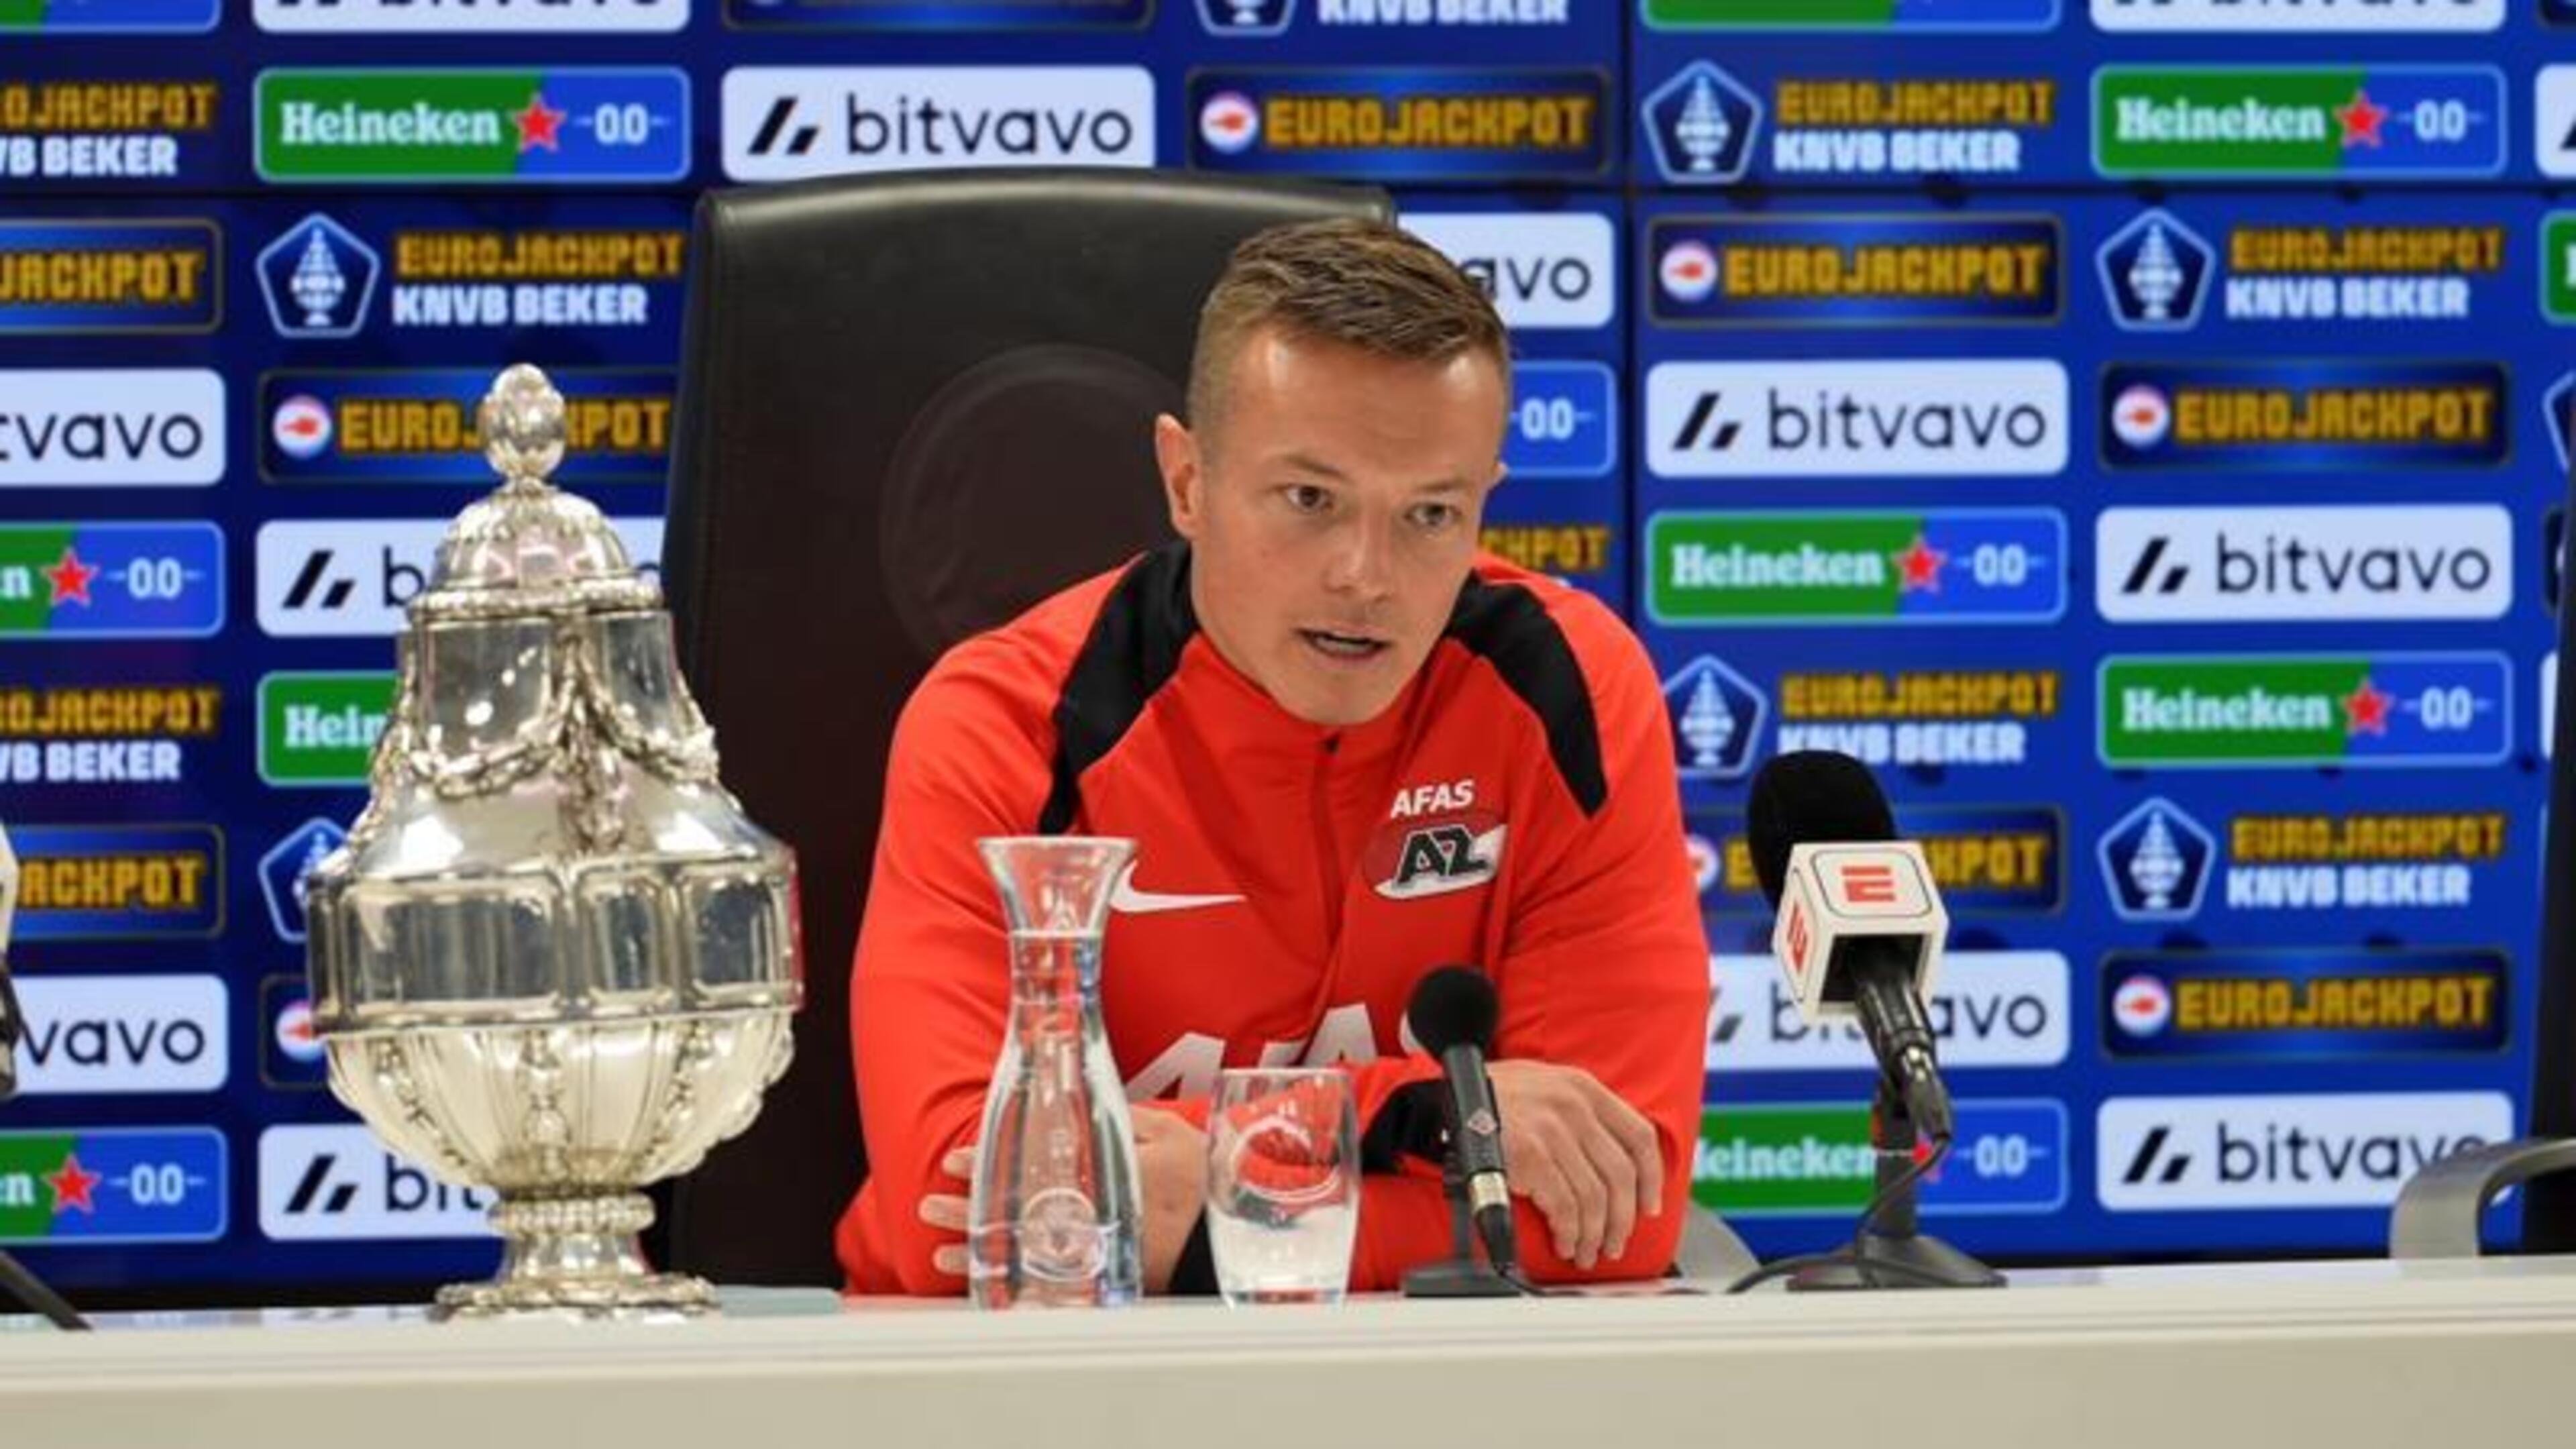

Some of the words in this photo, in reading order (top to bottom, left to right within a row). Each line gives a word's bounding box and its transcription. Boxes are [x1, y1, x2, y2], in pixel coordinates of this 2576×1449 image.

[0, 87, 211, 127] OJACKPOT
[282, 103, 499, 143] Heineken
[1267, 100, 1587, 145] EUROJACKPOT
[1780, 83, 2049, 123] EUROJACKPOT
[2118, 99, 2324, 139] Heineken
[848, 95, 1131, 154] bitvavo
[44, 138, 176, 174] BEKER
[1775, 132, 1885, 169] KNVB
[1891, 132, 2018, 170] BEKER
[398, 236, 680, 274] EUROJACKPOT
[2233, 232, 2498, 268] EUROJACKPOT
[1725, 248, 2040, 294] EUROJACKPOT
[394, 287, 506, 323] KNVB
[515, 286, 645, 323] BEKER
[2228, 280, 2334, 315] KNVB
[2343, 280, 2466, 315] BEKER
[1770, 391, 2045, 448] bitvavo
[2177, 392, 2485, 439] EUROJACKPOT
[1672, 545, 1883, 586] Heineken
[2218, 535, 2489, 592] bitvavo
[1784, 674, 2055, 716] EUROJACKPOT
[2124, 690, 2330, 729] Heineken
[47, 743, 179, 780] BEKER
[1896, 724, 2023, 762] BEKER
[1390, 779, 1474, 819] AFAS
[1397, 826, 1487, 884] AZ
[2235, 817, 2501, 858] EUROJACKPOT
[2229, 868, 2337, 904] KNVB
[2345, 867, 2468, 904] BEKER
[2178, 979, 2487, 1026] EUROJACKPOT
